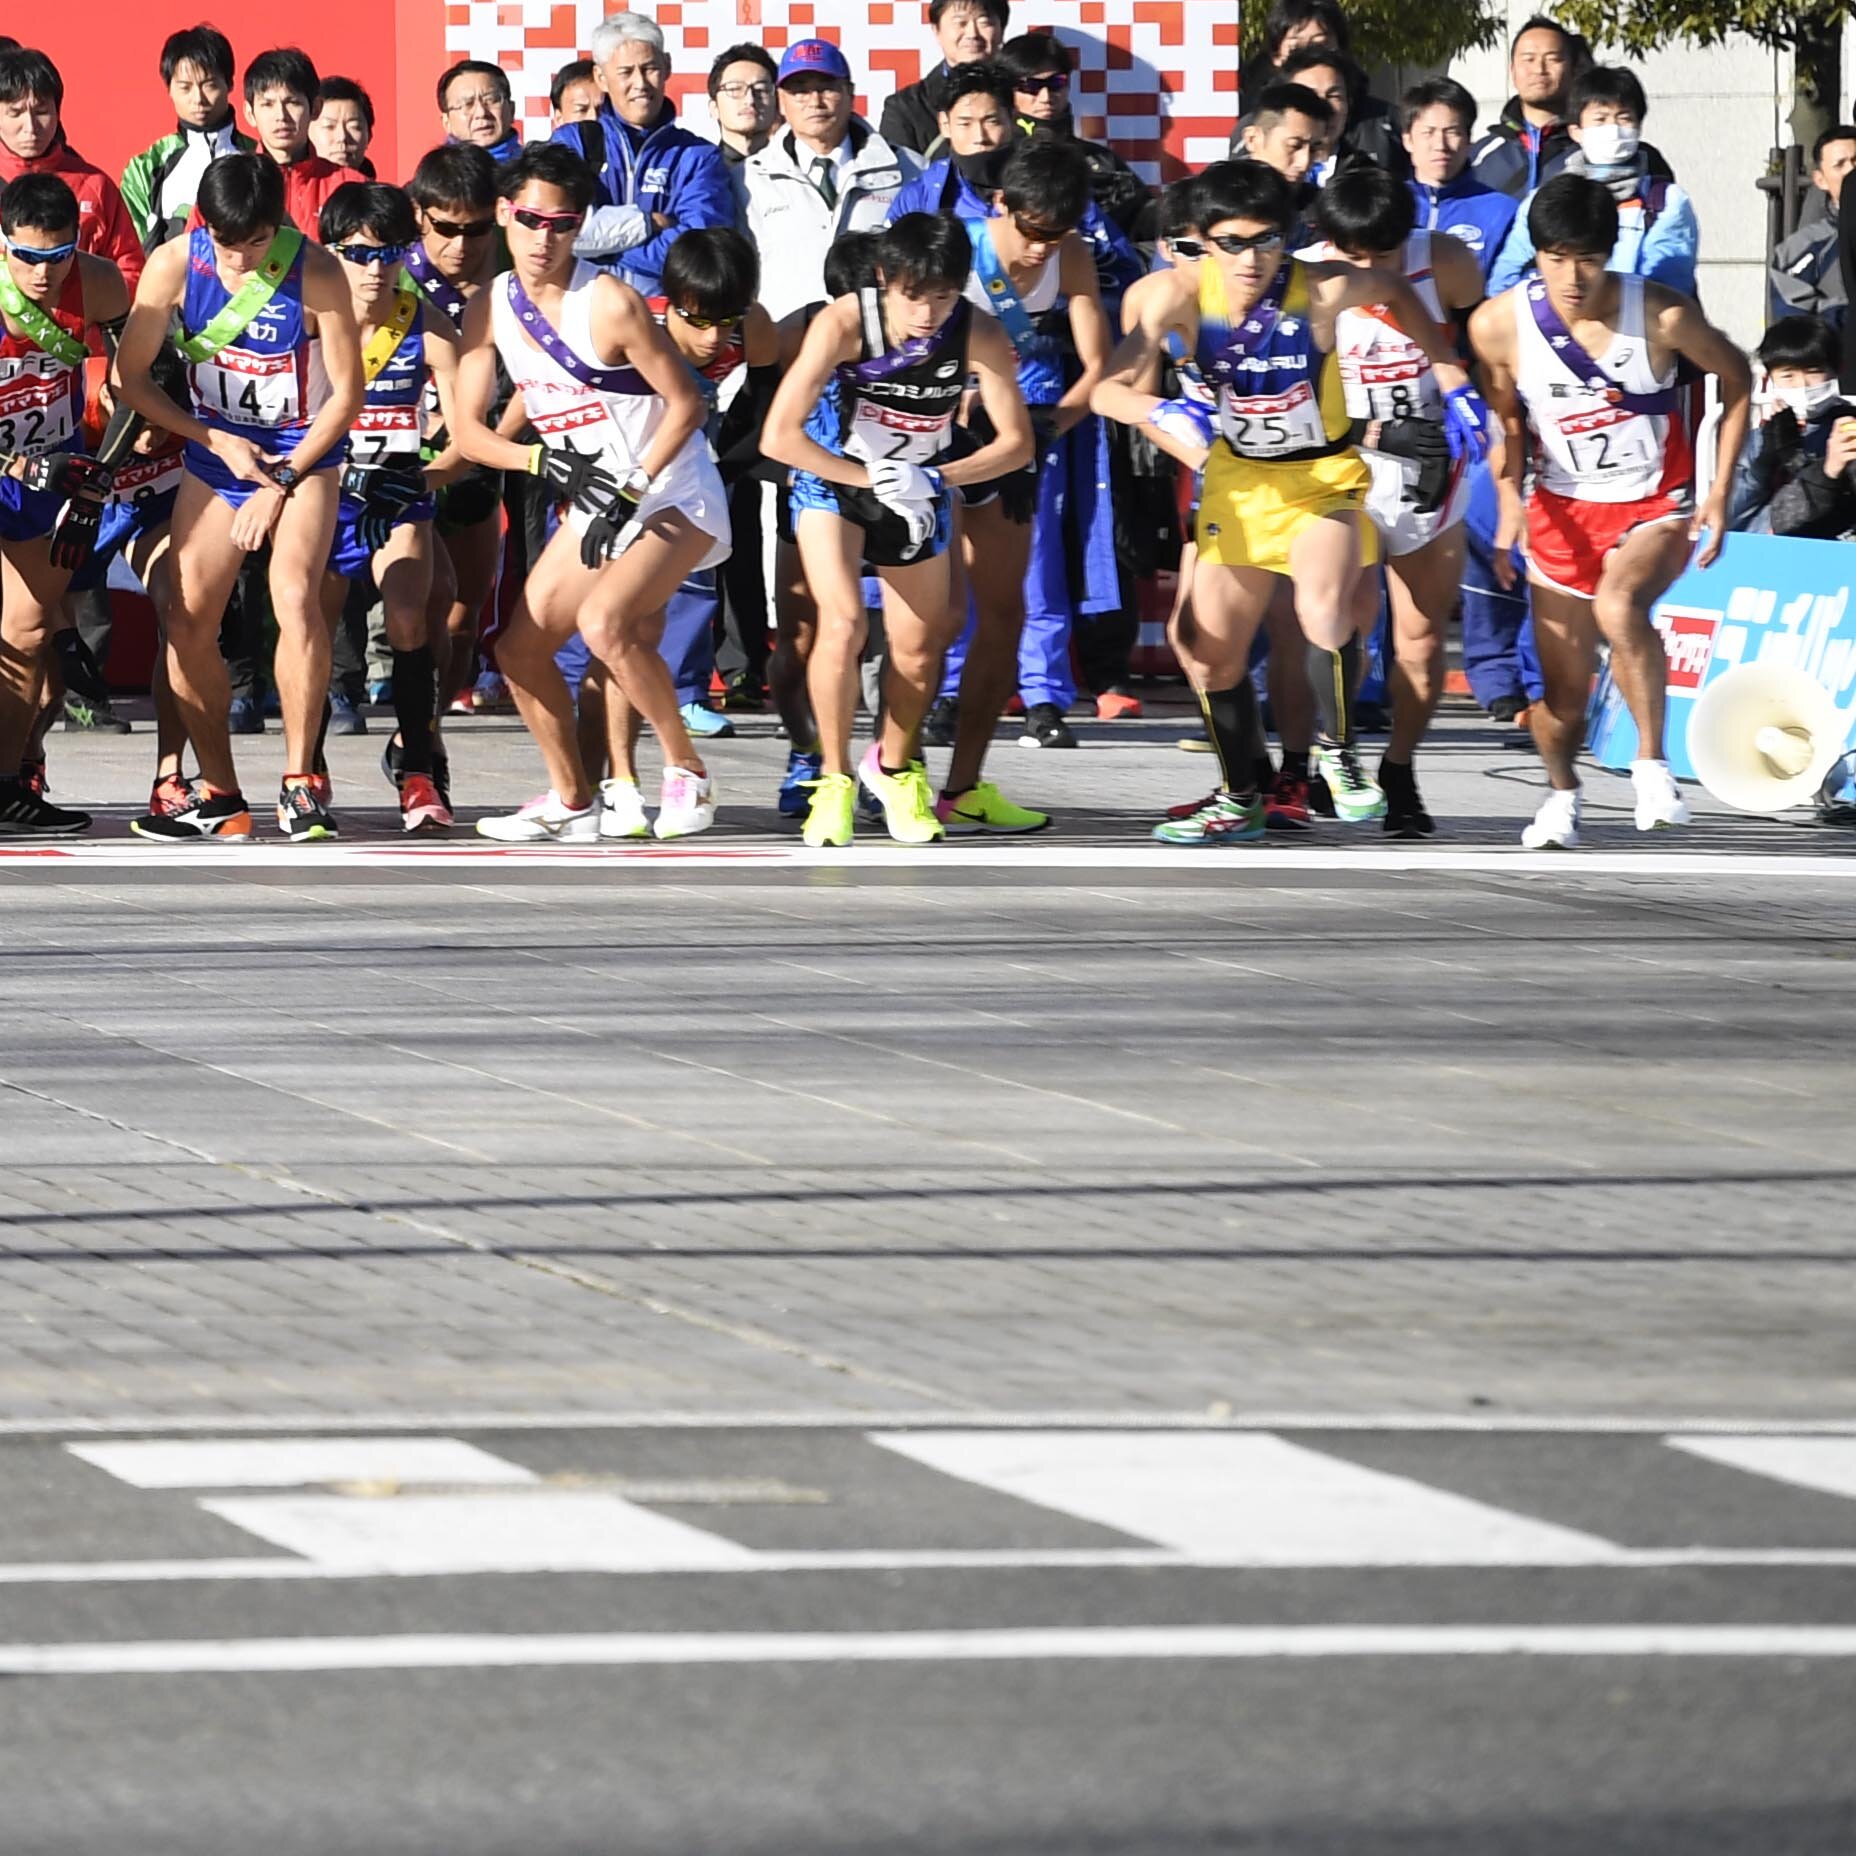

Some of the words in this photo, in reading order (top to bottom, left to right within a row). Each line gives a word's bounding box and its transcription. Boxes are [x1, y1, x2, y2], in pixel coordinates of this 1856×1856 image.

[0, 356, 58, 381] JFE
[219, 352, 288, 373] ヤマザキ
[218, 370, 289, 417] 14-1
[357, 410, 413, 427] マザキ
[1231, 414, 1316, 446] 25-1
